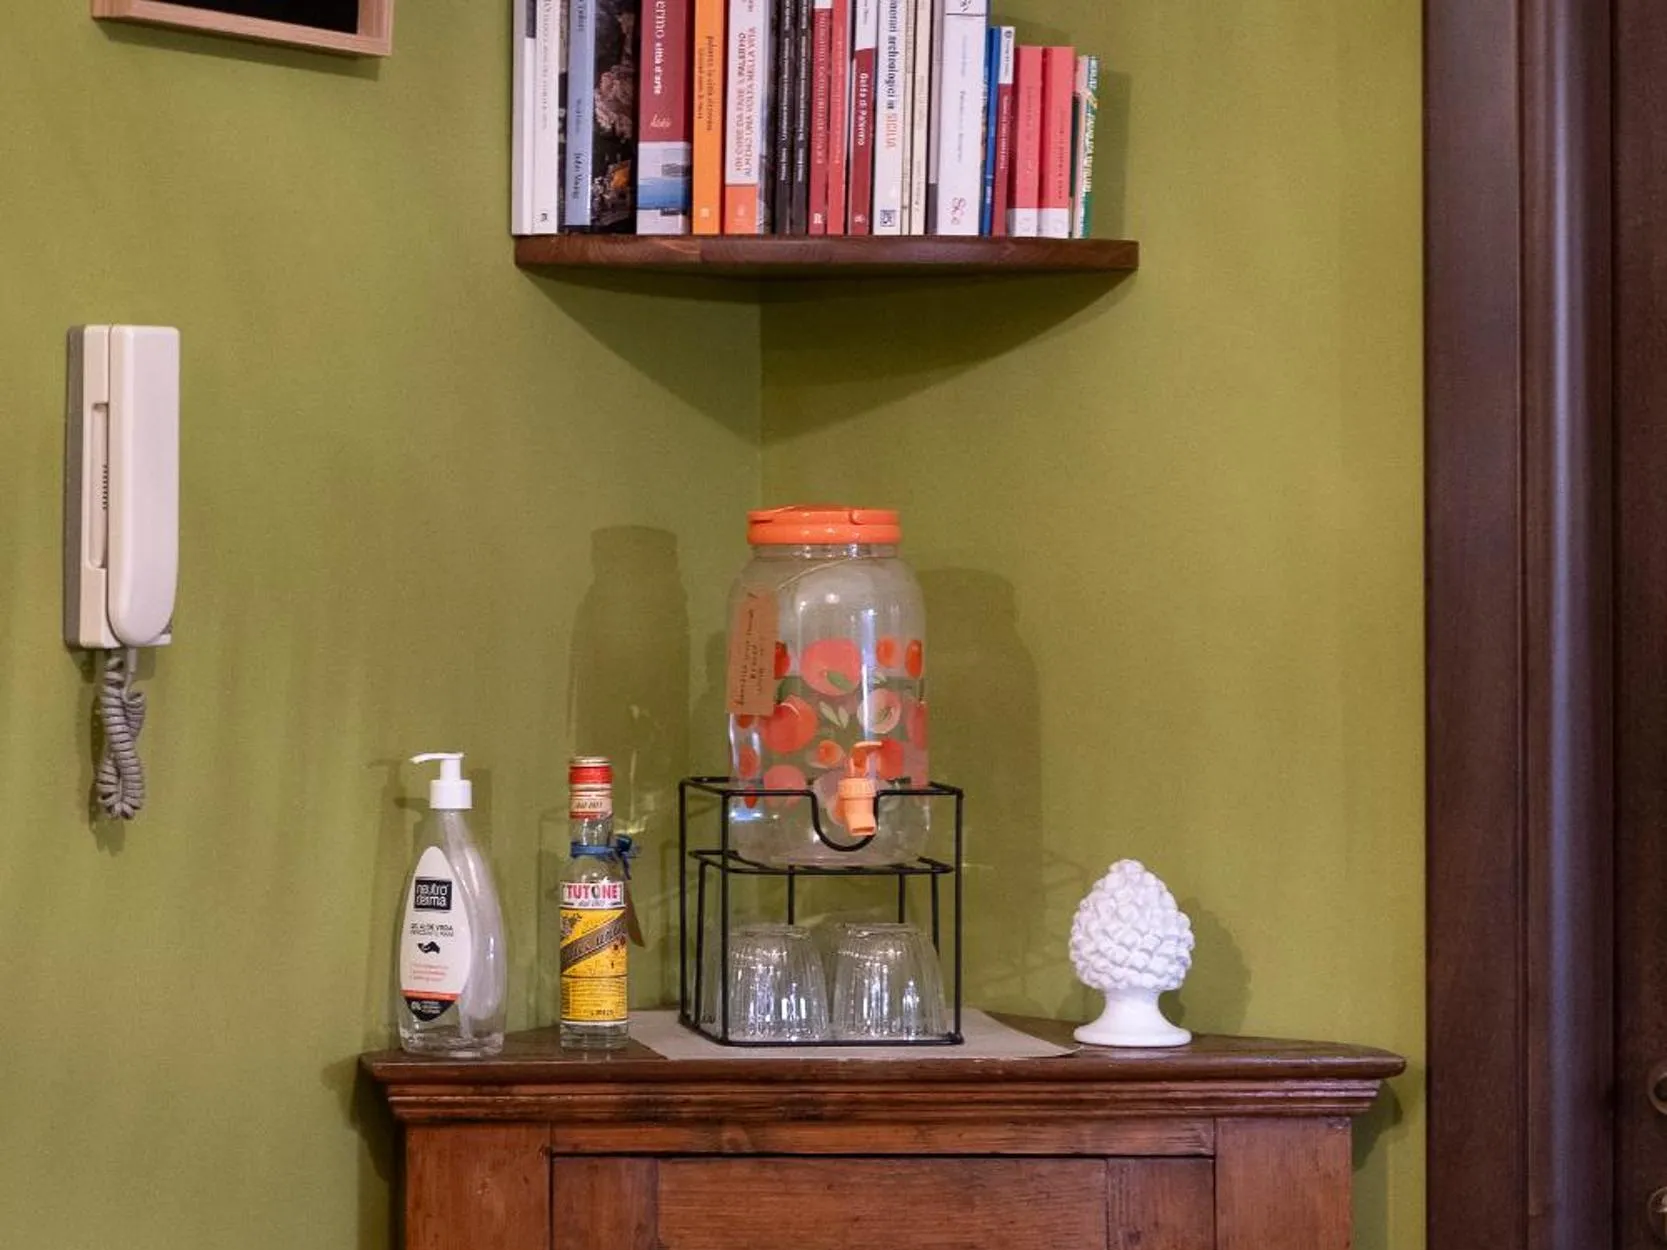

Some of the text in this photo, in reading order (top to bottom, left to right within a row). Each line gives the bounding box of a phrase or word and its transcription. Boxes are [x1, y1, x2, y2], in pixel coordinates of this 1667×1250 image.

[747, 26, 757, 47] VITA
[738, 32, 746, 77] PALERMO
[746, 48, 755, 81] NELLA
[885, 35, 899, 98] archeologici
[745, 84, 755, 113] VOLTA
[859, 72, 869, 98] Guida
[745, 115, 753, 136] UNA
[857, 110, 868, 146] Palermo
[886, 113, 897, 149] SICILIA
[416, 882, 448, 896] neutro
[416, 895, 447, 907] derma
[567, 883, 618, 900] TUTONE
